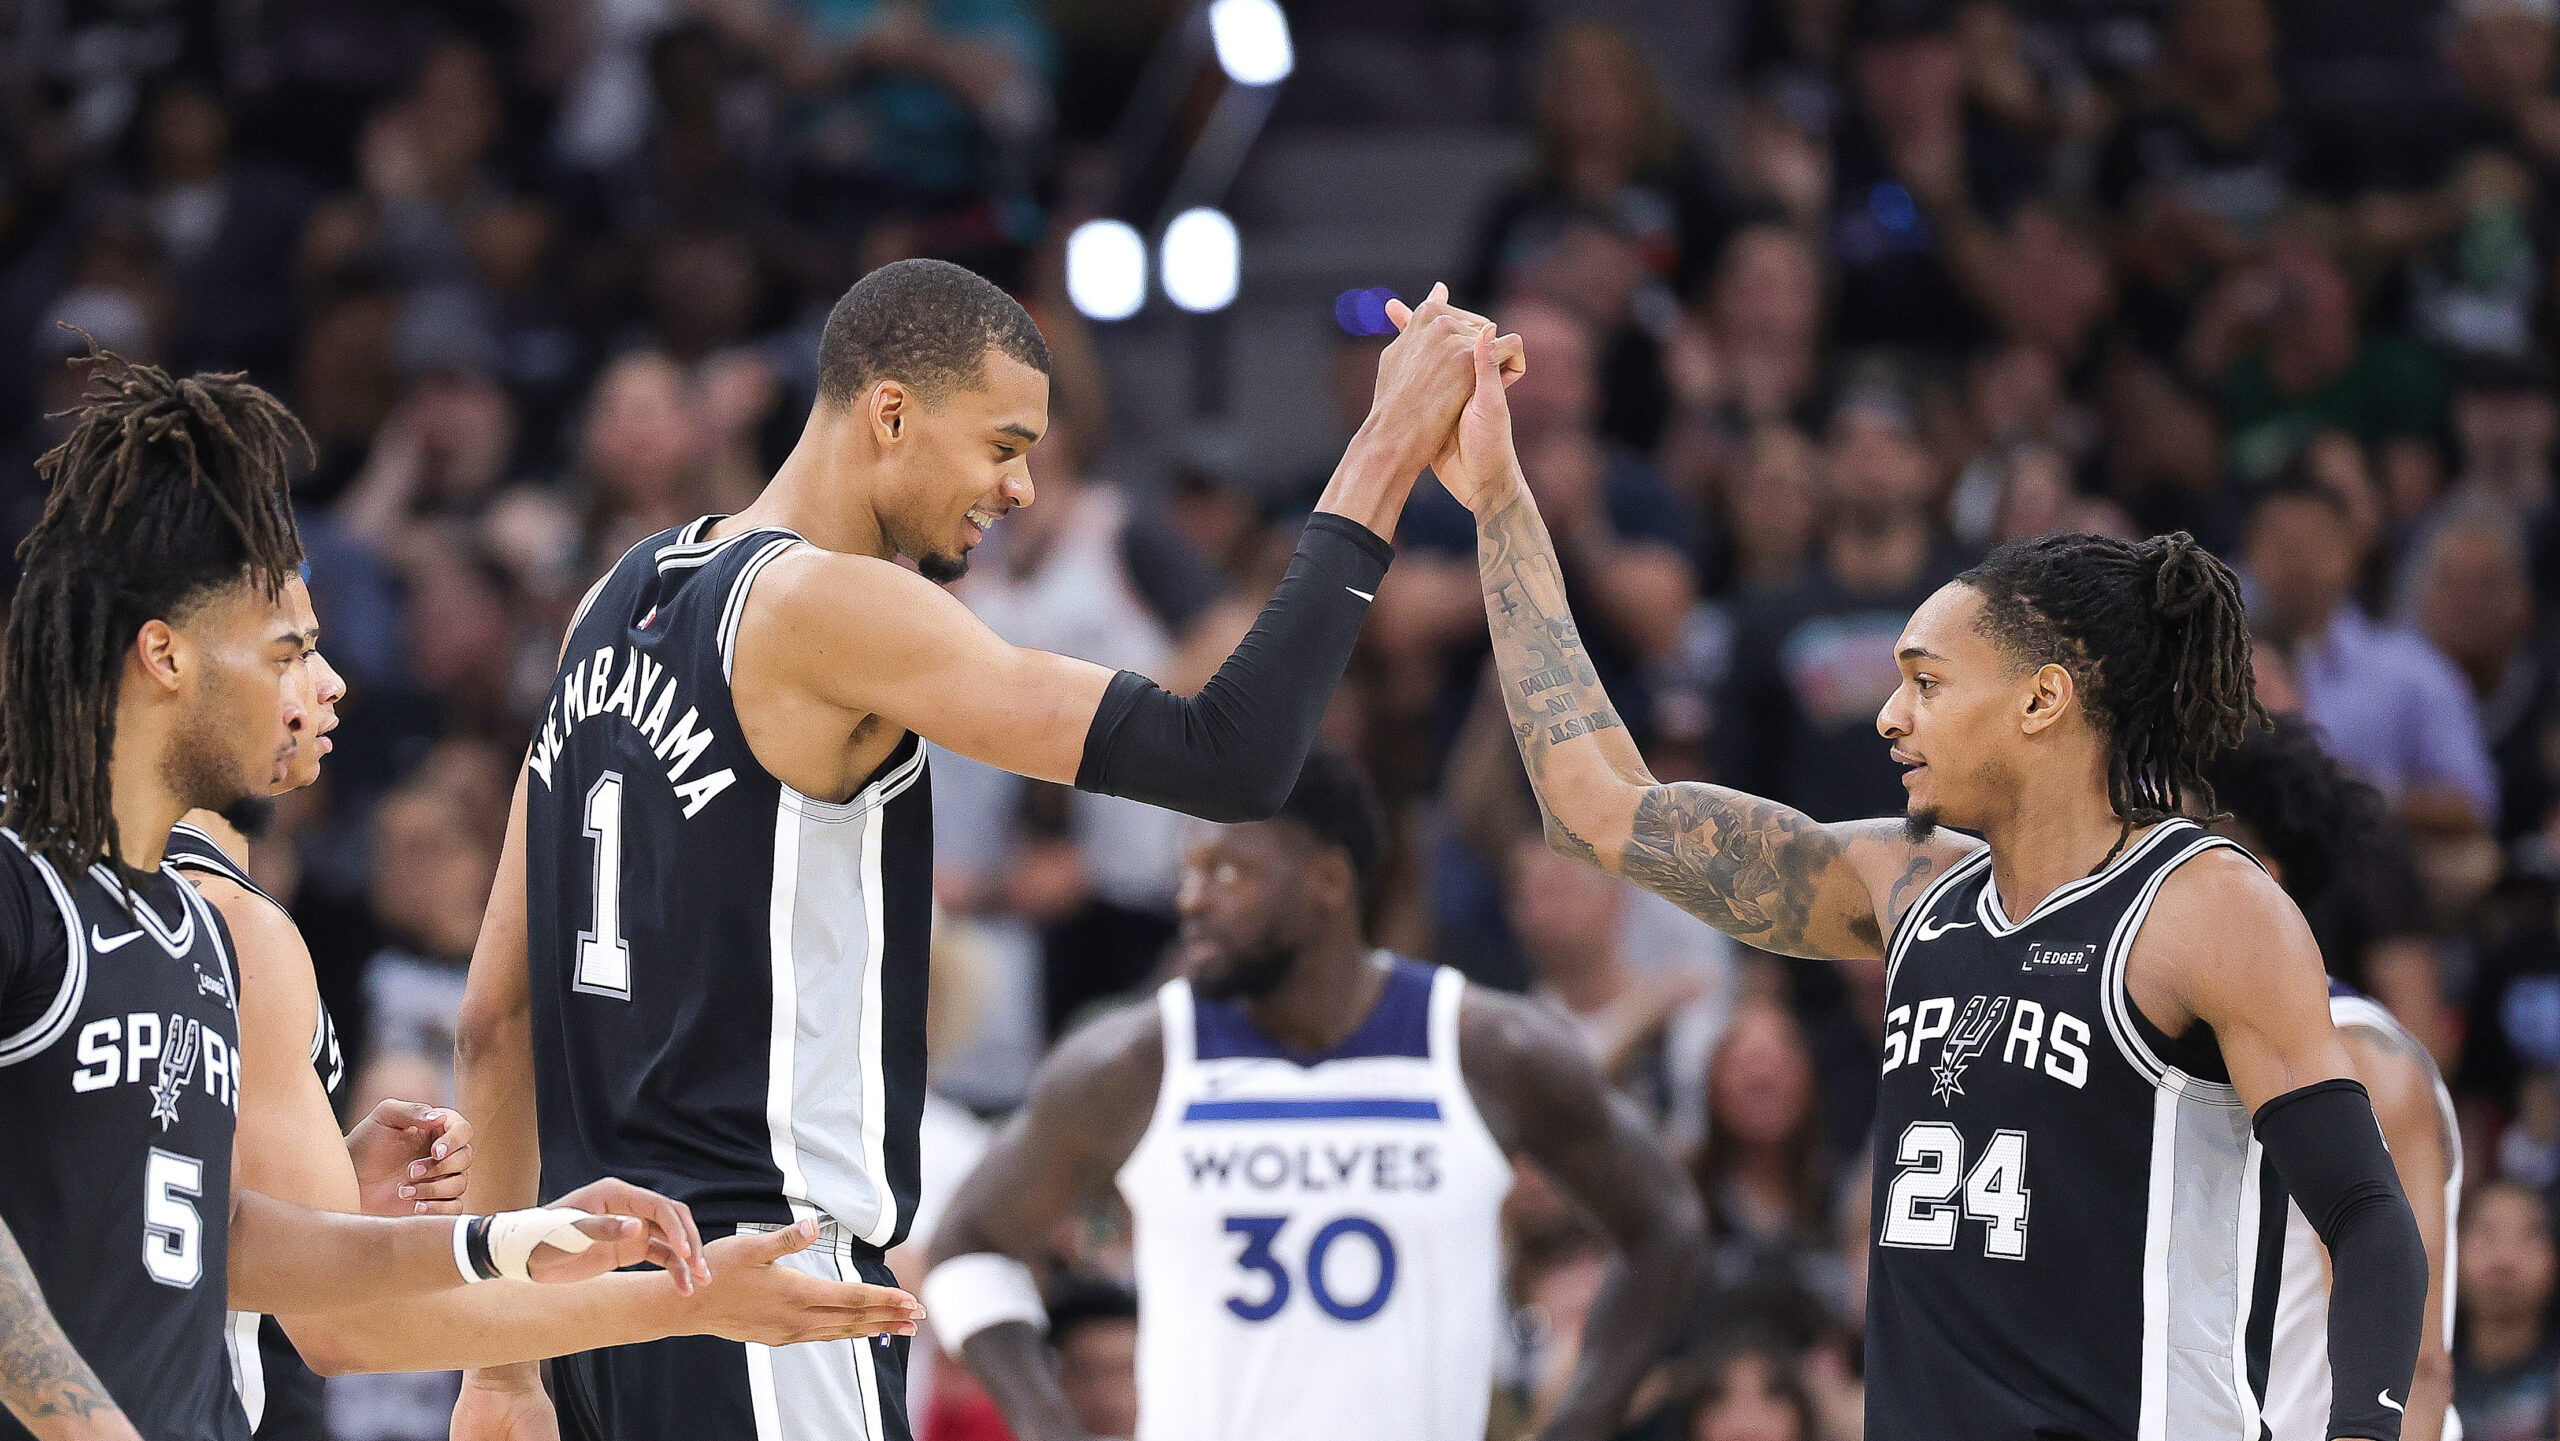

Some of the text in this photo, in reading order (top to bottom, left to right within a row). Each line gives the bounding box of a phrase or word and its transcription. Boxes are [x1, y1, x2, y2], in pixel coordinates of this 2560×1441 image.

[528, 645, 737, 820] WEMBAYAMA
[1519, 666, 1573, 696] HIM
[1546, 693, 1577, 716] IN
[572, 769, 632, 1001] 1
[2033, 950, 2084, 965] LEDGER
[1881, 995, 2092, 1107] SPURS
[143, 1147, 204, 1289] 5
[1183, 1143, 1442, 1191] WOLVES
[1878, 1120, 2031, 1261] 24
[1224, 1214, 1398, 1322] 30
